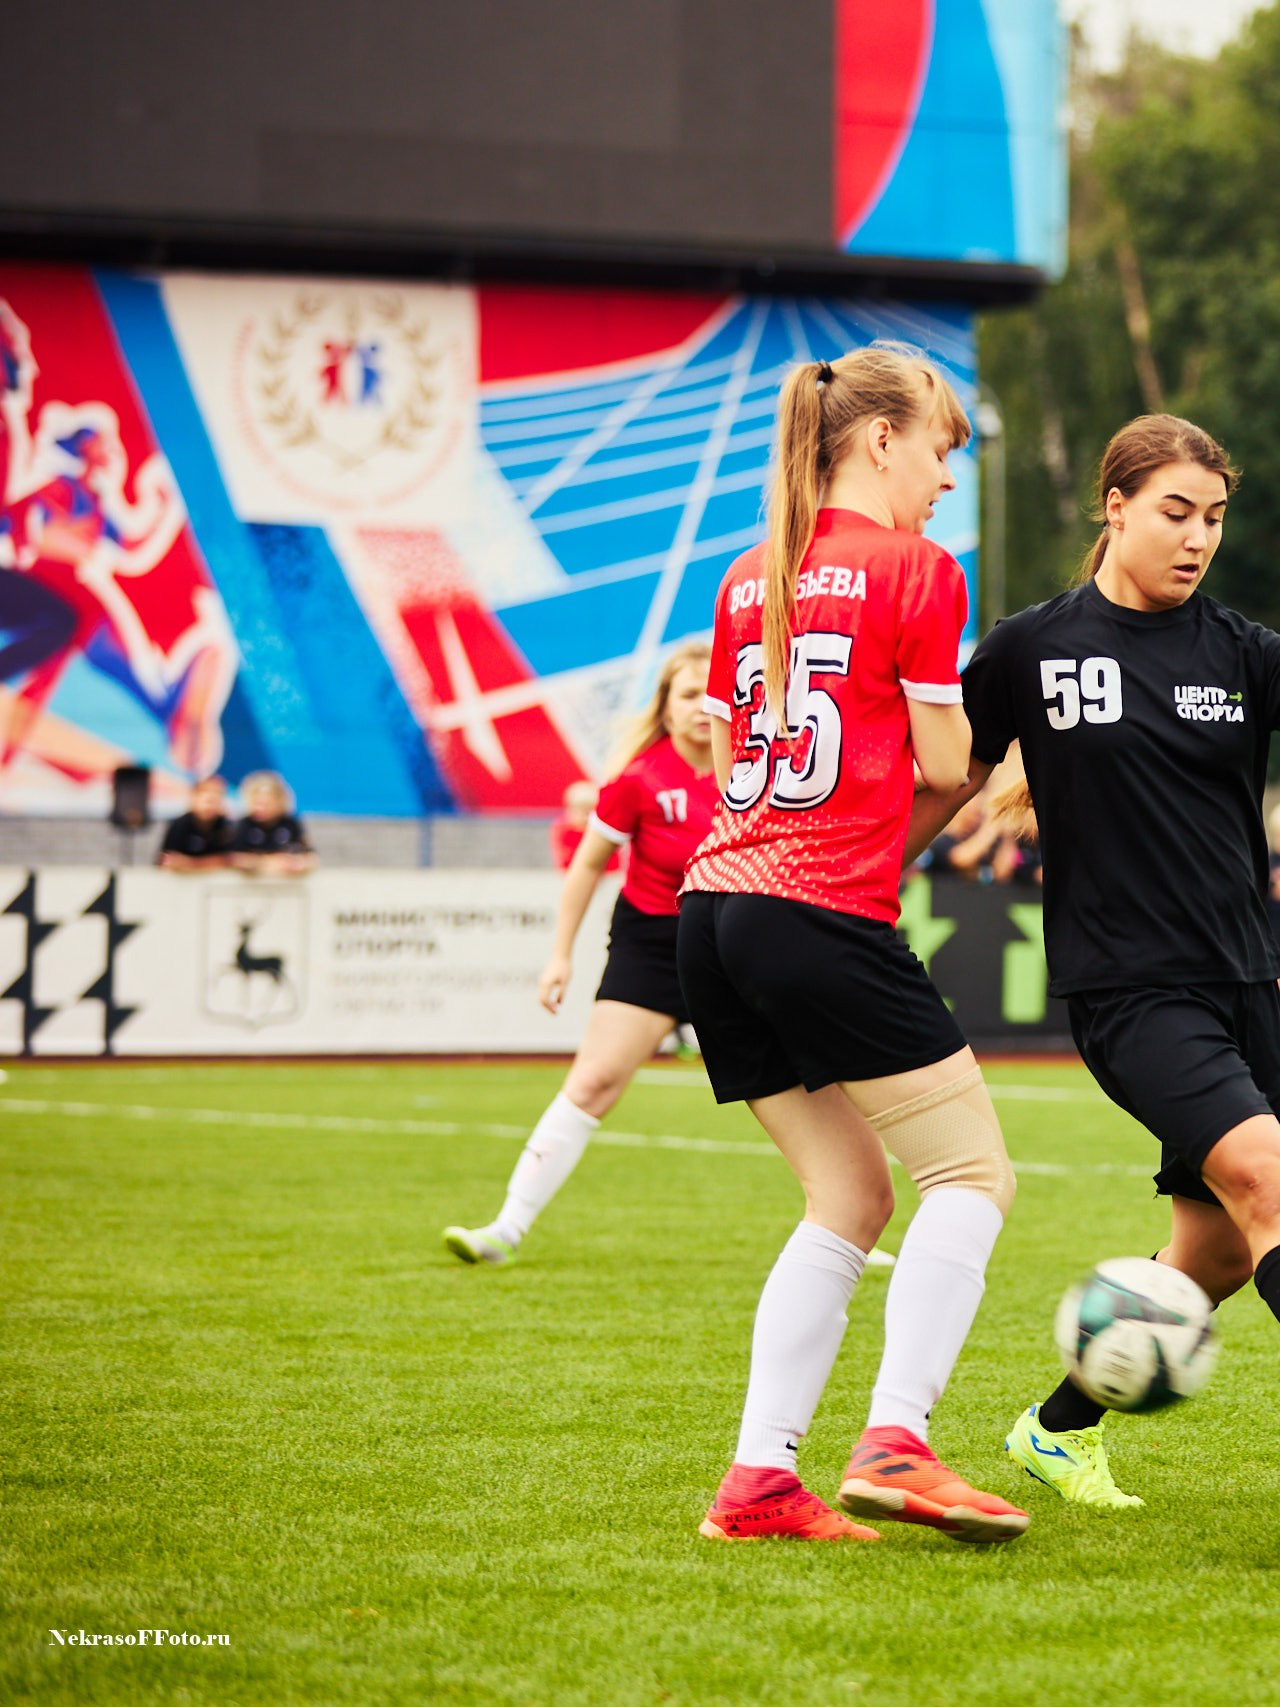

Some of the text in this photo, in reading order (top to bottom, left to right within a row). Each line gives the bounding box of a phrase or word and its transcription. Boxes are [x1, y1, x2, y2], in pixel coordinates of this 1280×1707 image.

[730, 565, 867, 615] ВОРБЬЕВА
[1039, 656, 1123, 730] 59
[1174, 685, 1228, 705] ЦЕНТР
[721, 630, 853, 812] 35
[1176, 703, 1245, 722] СПОРТА
[655, 787, 688, 824] 17
[725, 1507, 784, 1523] NEMESIS
